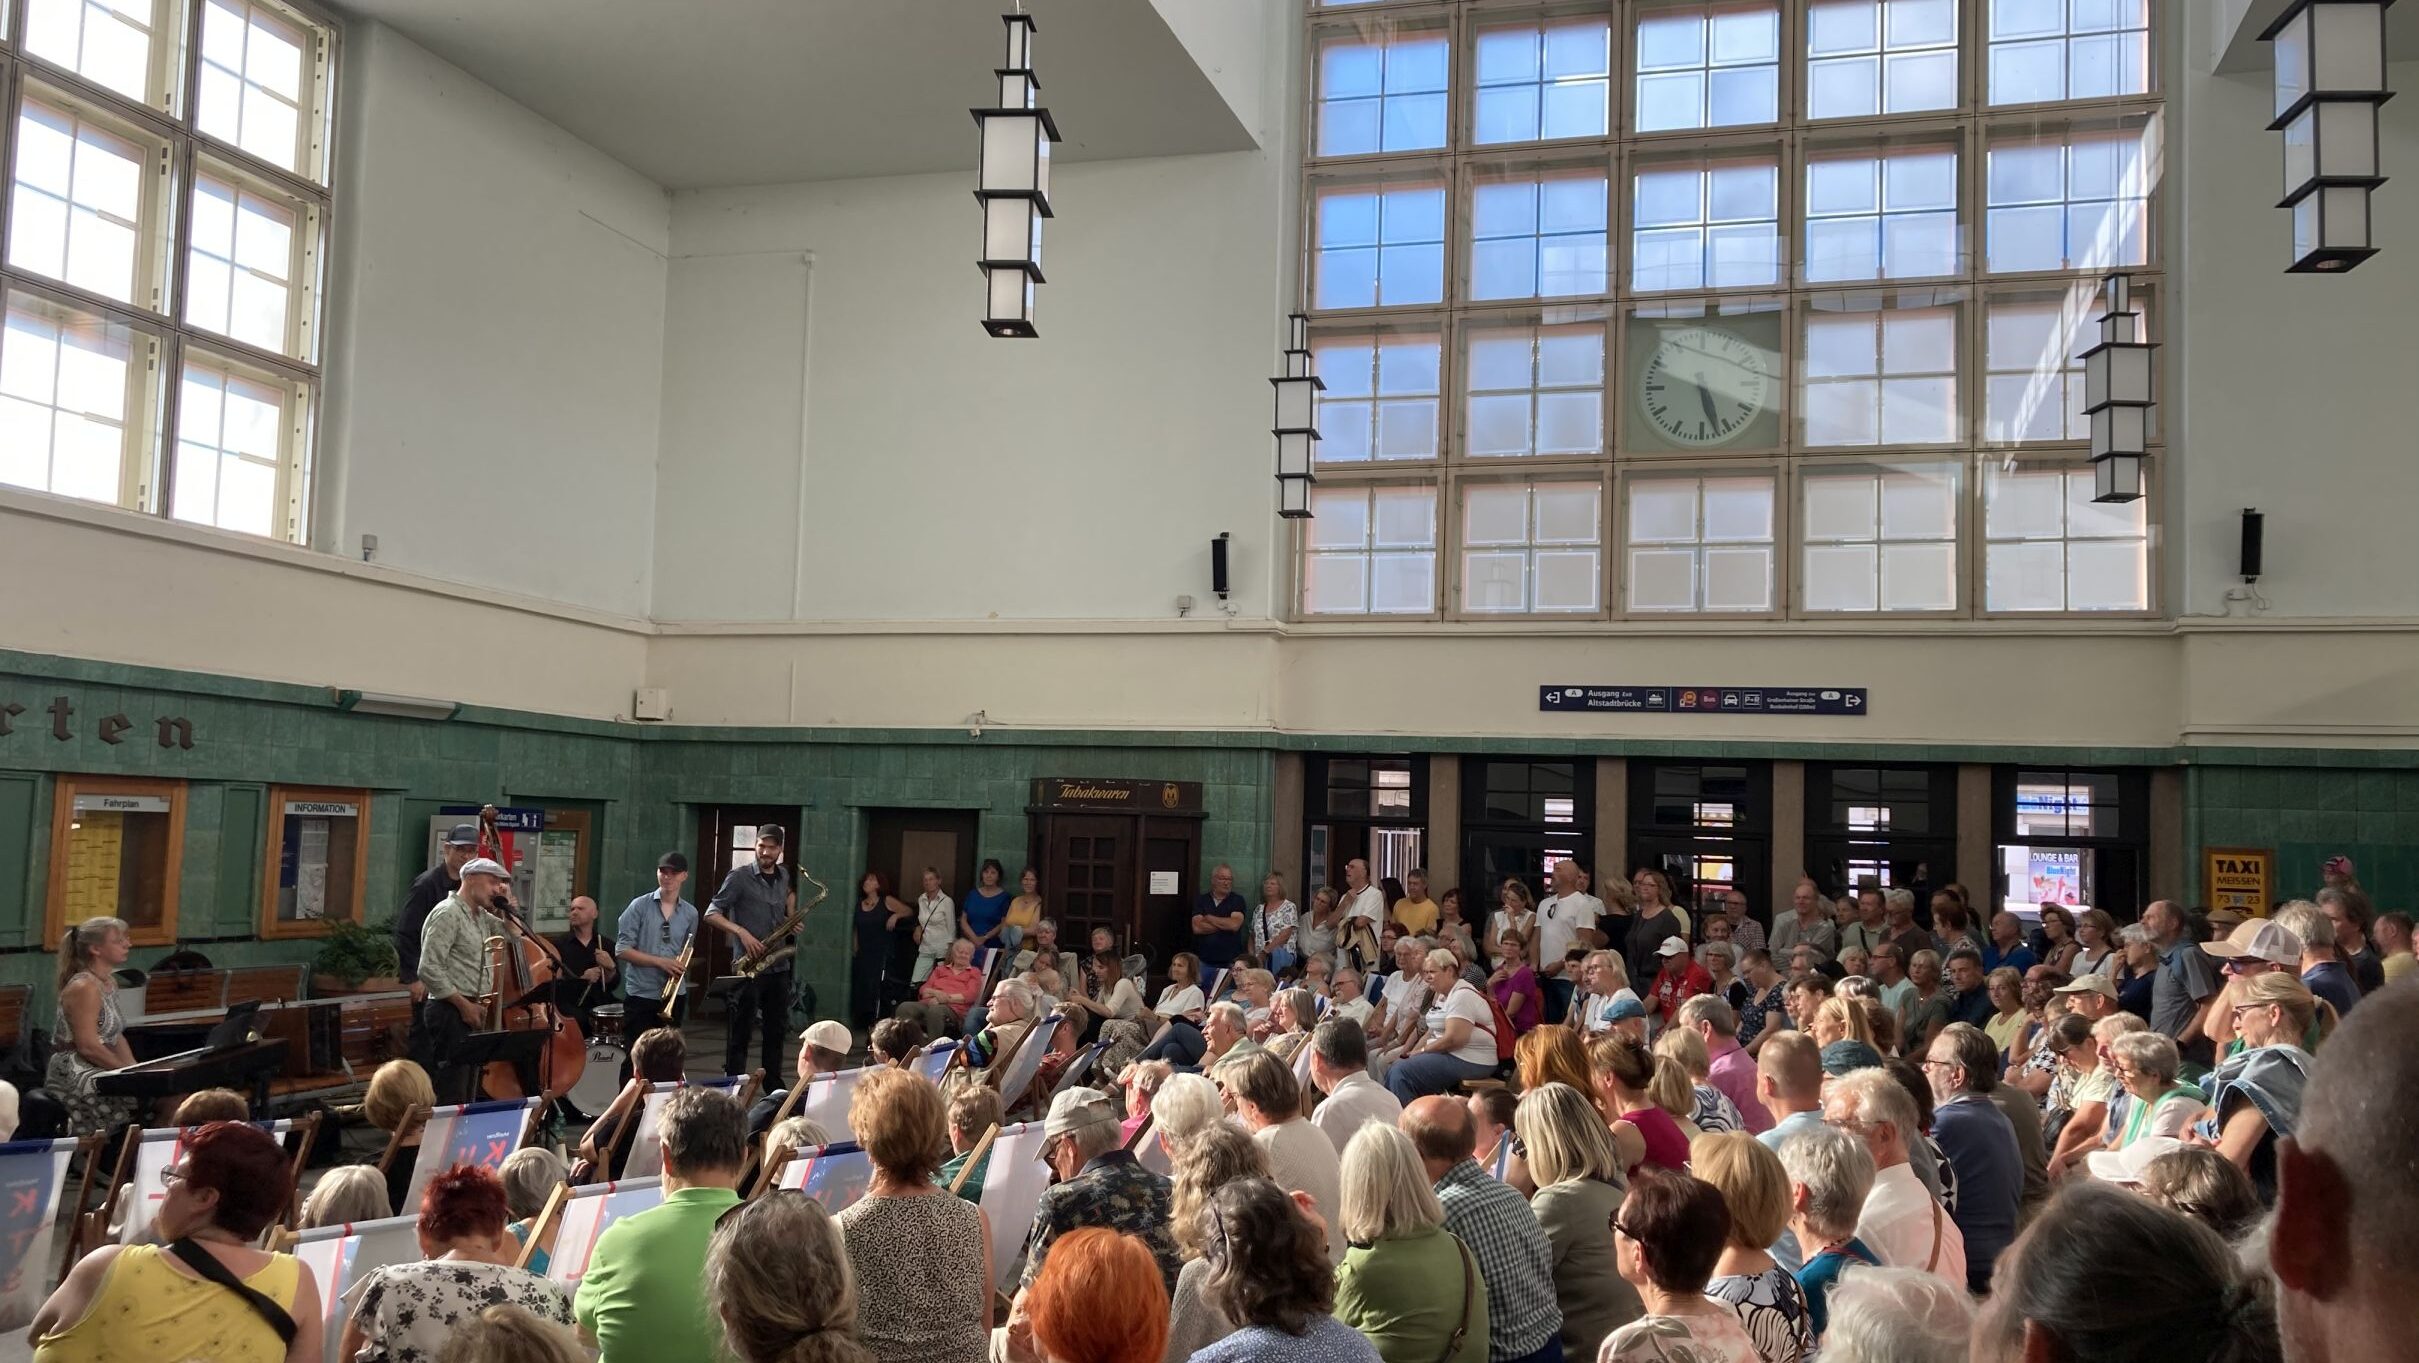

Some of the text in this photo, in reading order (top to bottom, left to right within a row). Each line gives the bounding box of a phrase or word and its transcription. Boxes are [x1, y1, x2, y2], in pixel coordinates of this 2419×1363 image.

[1588, 689, 1620, 699] Ausgang
[1704, 695, 1716, 703] Bus
[1588, 699, 1642, 708] Altstadtbrücke
[1059, 784, 1130, 800] Tabakwaren
[104, 798, 139, 809] Fahrplan
[295, 803, 346, 814] INFORMATION
[2031, 852, 2057, 862] LOUNGE
[2064, 853, 2078, 862] BAR
[2216, 860, 2260, 874] TAXI
[2216, 876, 2260, 885] MEISSEN
[2217, 894, 2230, 903] 73
[2247, 895, 2260, 904] 23
